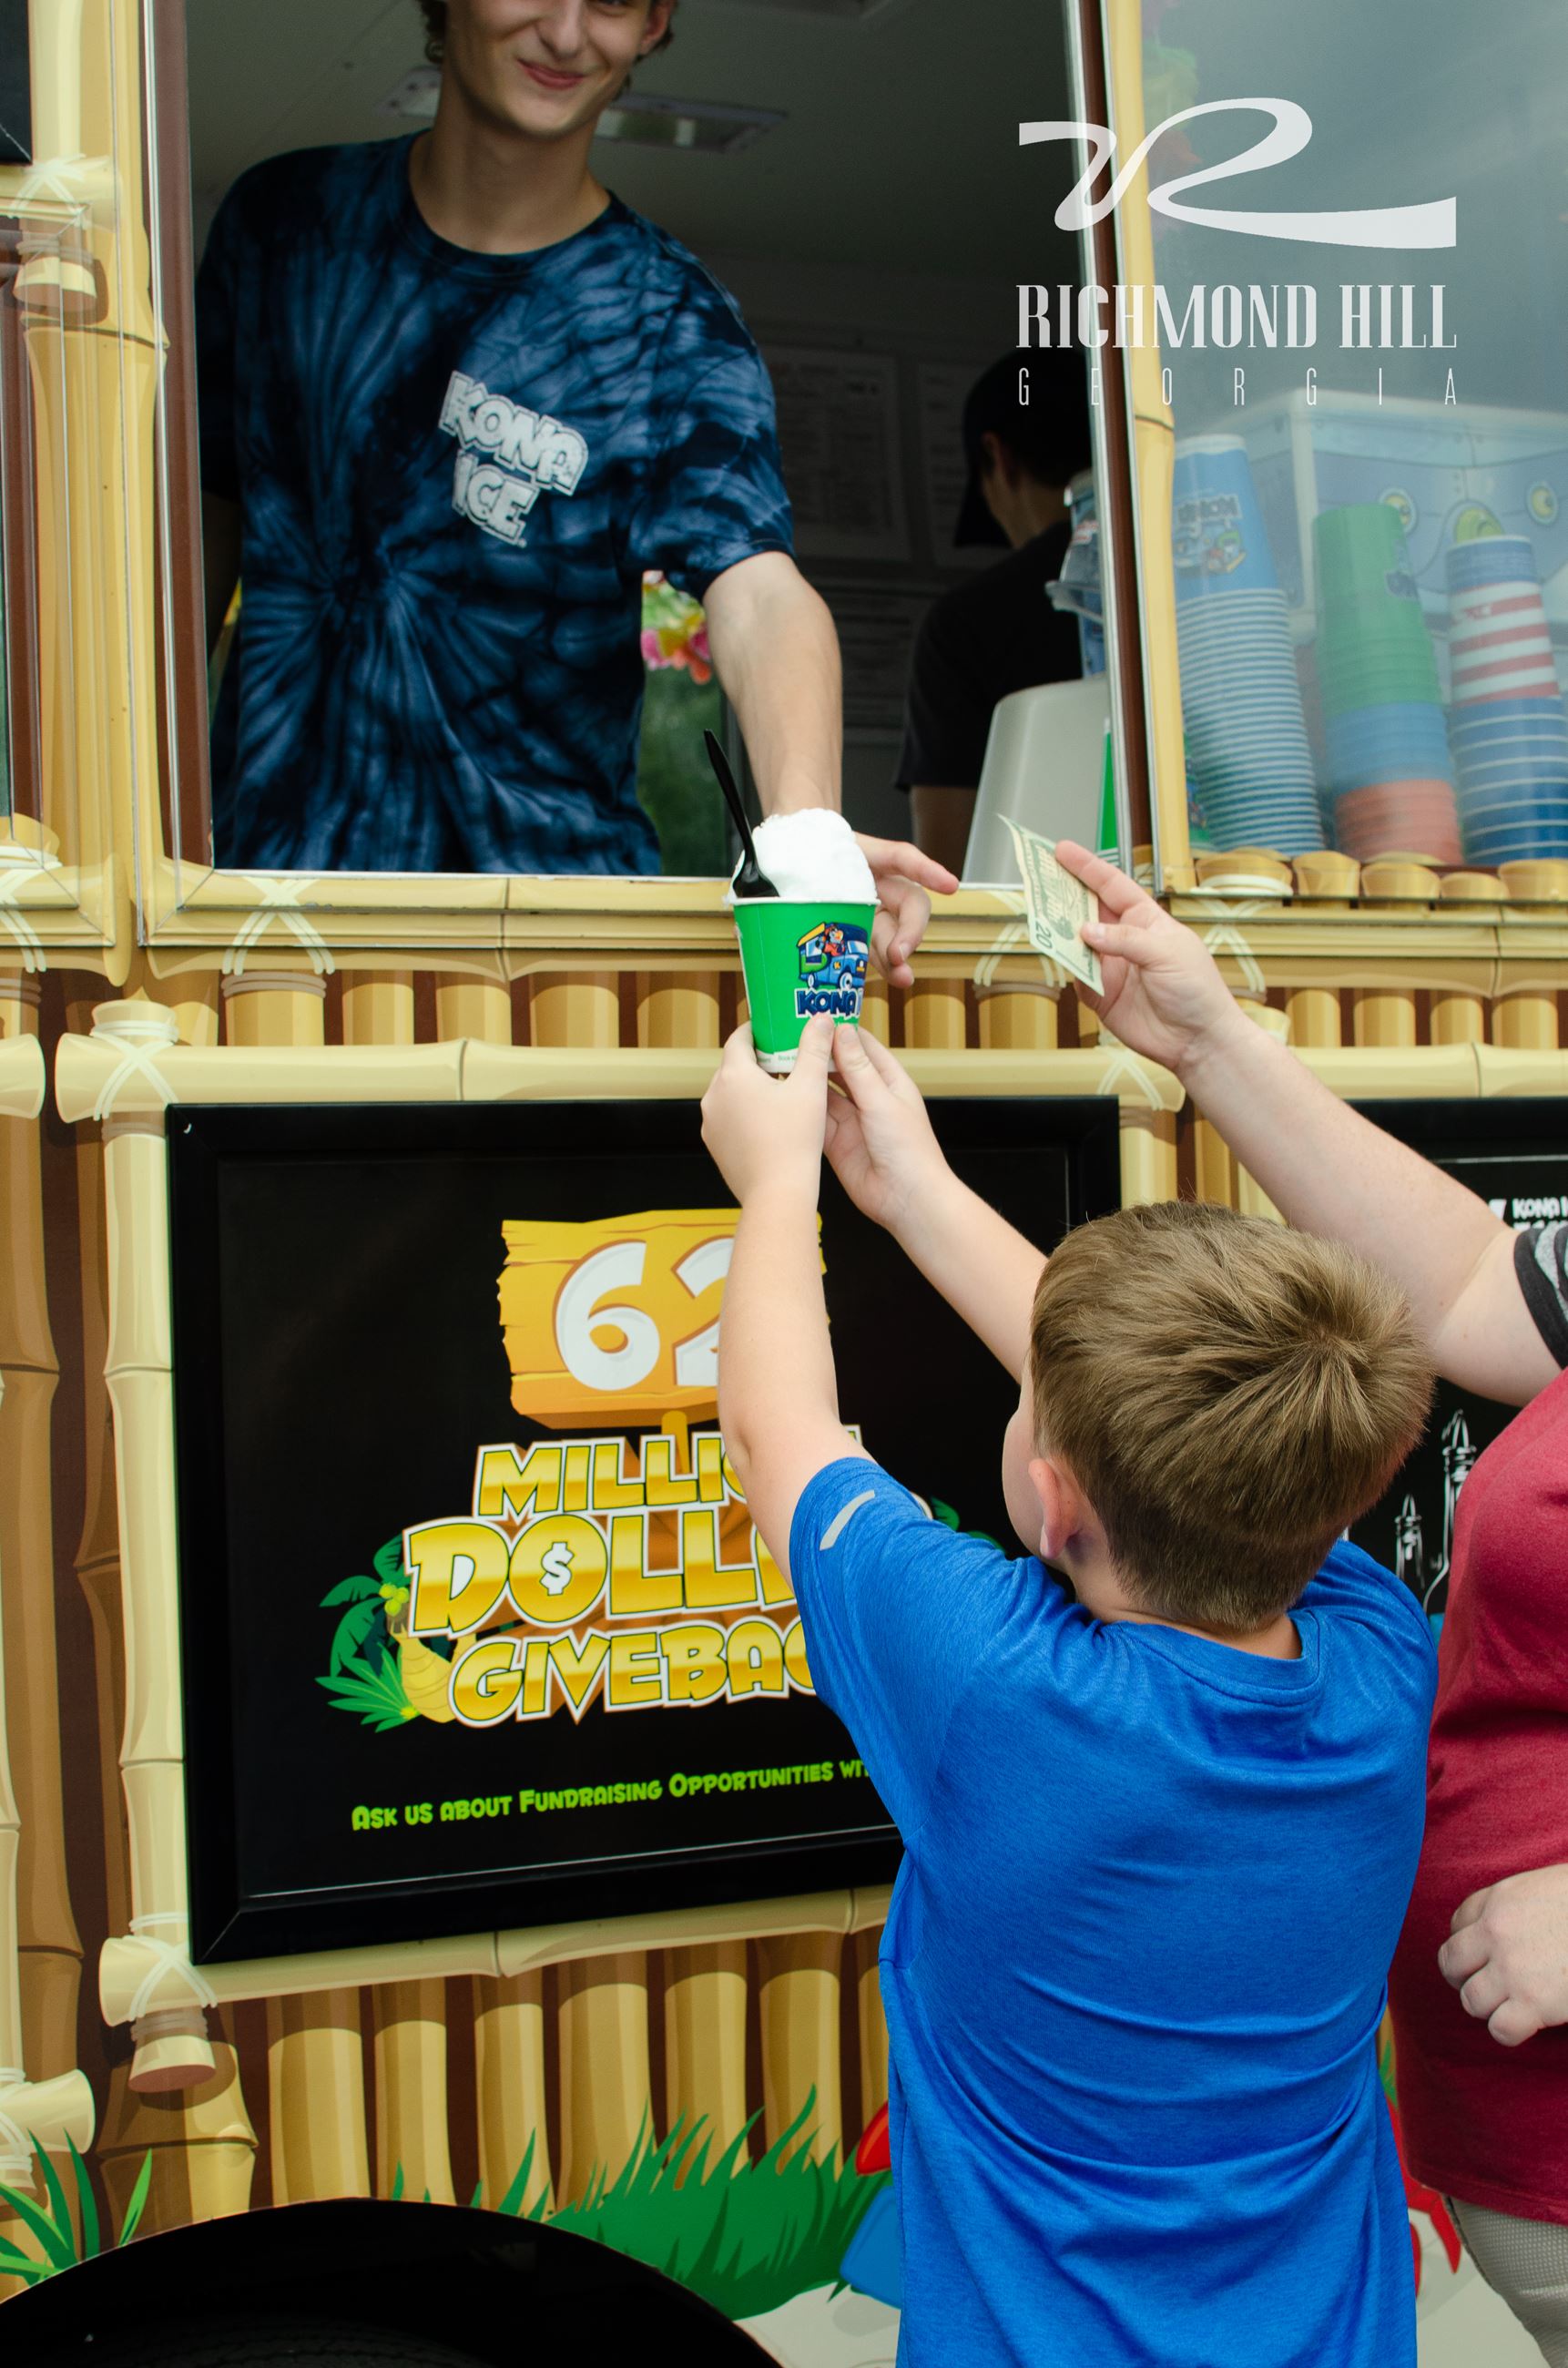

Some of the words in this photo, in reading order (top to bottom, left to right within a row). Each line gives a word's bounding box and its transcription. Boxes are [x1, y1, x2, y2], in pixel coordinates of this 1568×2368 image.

[439, 371, 588, 496] KONA
[453, 450, 540, 546] ICE
[795, 988, 859, 1019] KONA
[1512, 1197, 1561, 1219] KONA
[475, 1434, 750, 1519] MILLI
[402, 1507, 796, 1638] DOLL
[450, 1618, 816, 1728] GIVEBAC
